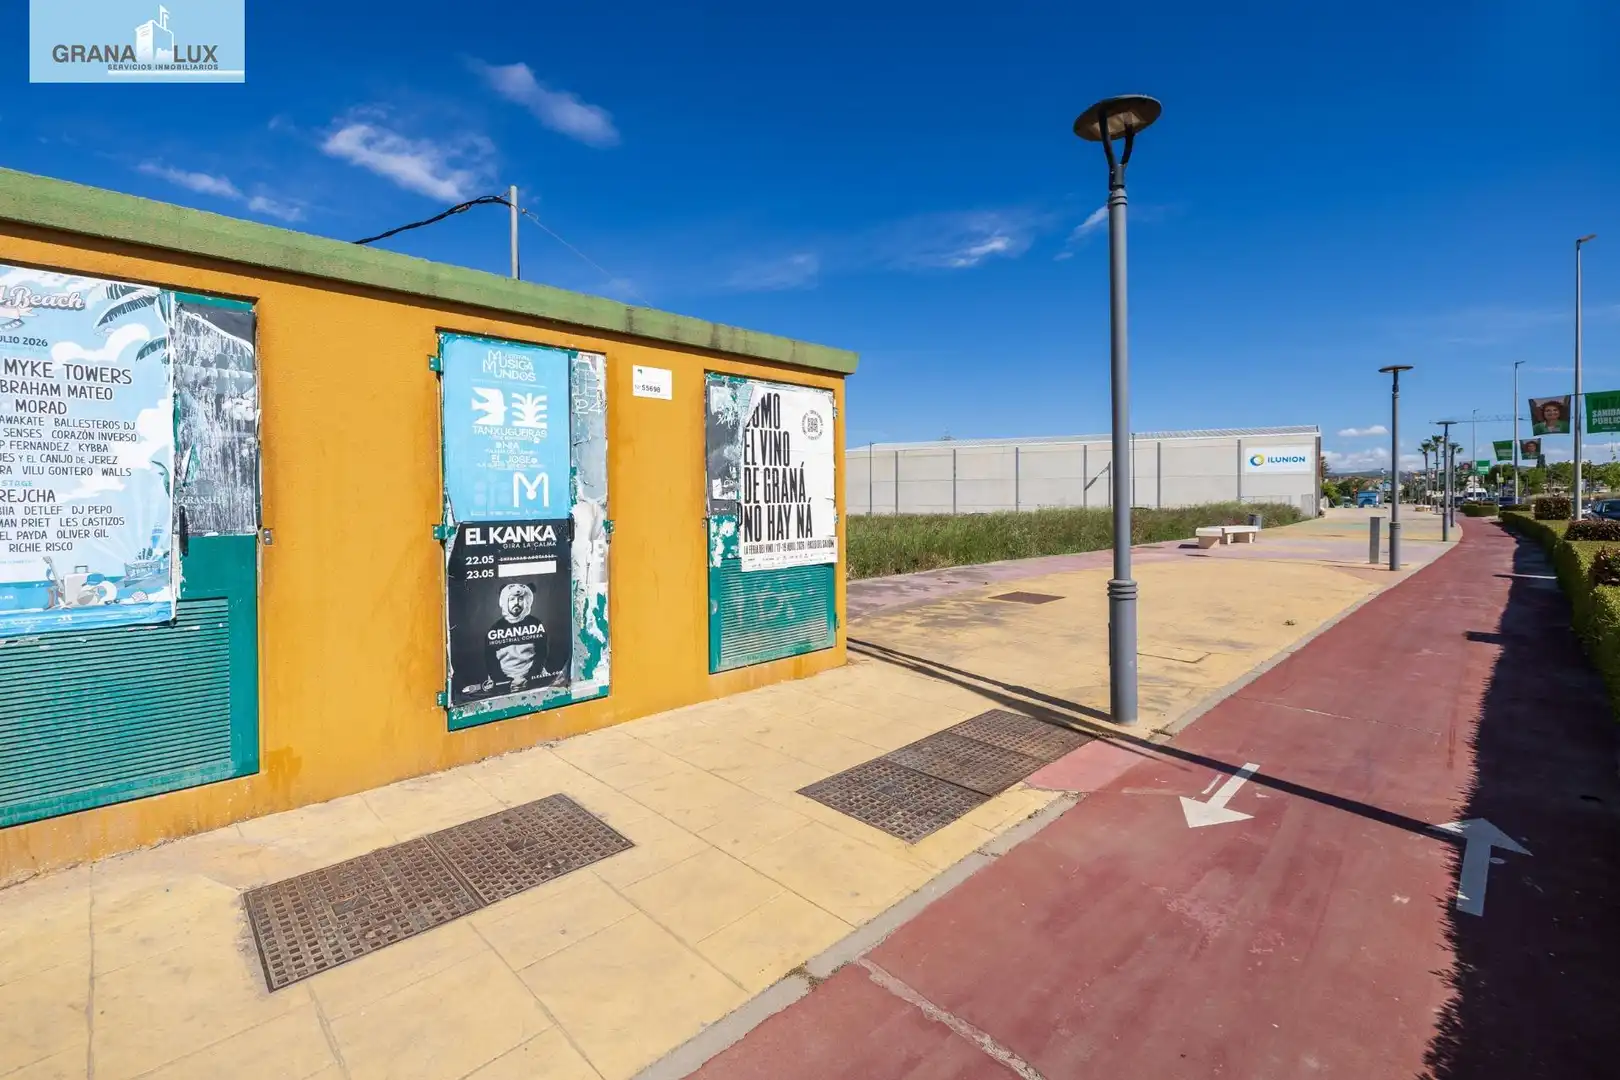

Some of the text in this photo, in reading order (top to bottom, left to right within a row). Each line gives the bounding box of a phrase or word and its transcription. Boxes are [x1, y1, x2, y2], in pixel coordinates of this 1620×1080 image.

[9, 284, 86, 311] Beach
[22, 336, 48, 347] 2026
[4, 358, 133, 385] MYKE TOWERS
[0, 379, 113, 400] BRAHAM MATEO
[15, 398, 67, 415] MORAD
[746, 392, 780, 429] OMO
[54, 417, 121, 430] BALLESTEROS
[123, 421, 136, 430] DJ
[3, 428, 137, 442] SENSES CORAZÓN INVERSO
[472, 426, 548, 439] TANXUGUEIRAS
[9, 440, 70, 452] FERNANDEZ
[78, 442, 109, 453] KYBBA
[744, 428, 790, 467] EL VINO
[18, 454, 24, 462] Y
[27, 454, 37, 463] EL
[40, 454, 73, 464] CANIJO
[75, 456, 86, 464] DE
[88, 456, 118, 465] JEREZ
[22, 466, 45, 475] VILU
[48, 466, 94, 476] GONTERO
[101, 467, 132, 477] WALLS
[744, 467, 759, 504] DE
[24, 505, 63, 516] DETLEF
[71, 506, 85, 515] DJ
[88, 505, 113, 515] PEPO
[21, 518, 51, 528] PRIET
[60, 517, 79, 527] LES
[81, 516, 125, 527] CASTIZOS
[744, 497, 813, 543] NO HAY NÁ
[16, 530, 48, 541] PAYDA
[56, 529, 91, 539] OLIVER
[94, 528, 109, 538] GIL
[465, 525, 557, 546] EL KANKA
[9, 542, 73, 552] RICHIE RISCO
[465, 555, 495, 566] 22.05
[466, 569, 495, 579] 23.05
[487, 624, 546, 640] GRANADA
[489, 637, 521, 645] INDUSTRIAL
